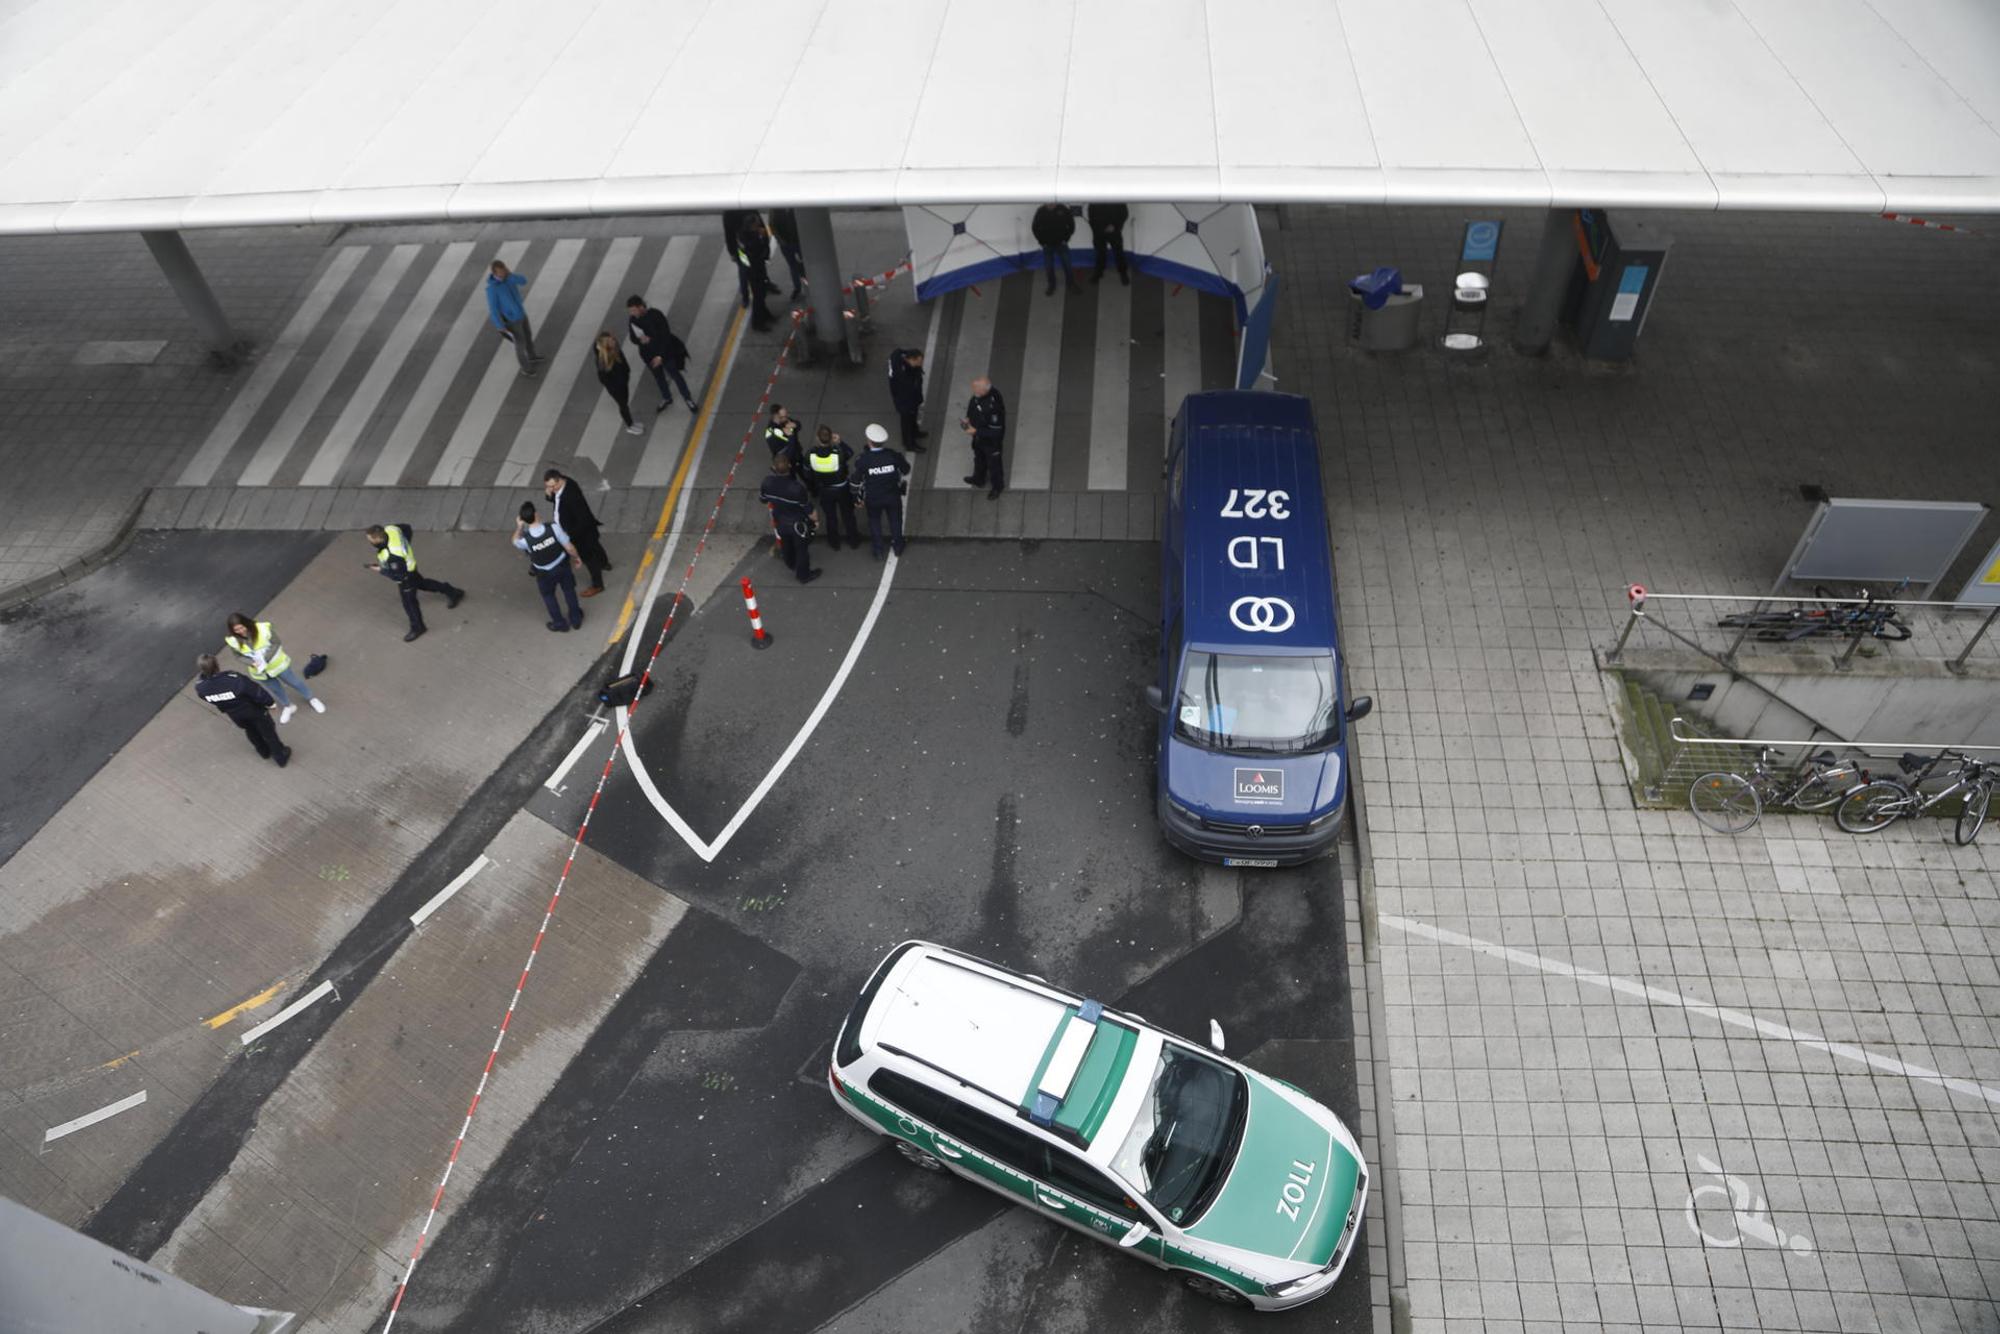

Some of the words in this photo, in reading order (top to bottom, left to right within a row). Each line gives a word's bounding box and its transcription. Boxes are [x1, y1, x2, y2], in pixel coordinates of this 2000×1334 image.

[868, 464, 895, 475] POLIZEI
[1220, 488, 1291, 520] 327
[531, 536, 556, 551] POLIZEI
[1227, 536, 1285, 570] LD
[1239, 783, 1279, 794] LOOMIS
[1276, 1160, 1316, 1223] ZOLL
